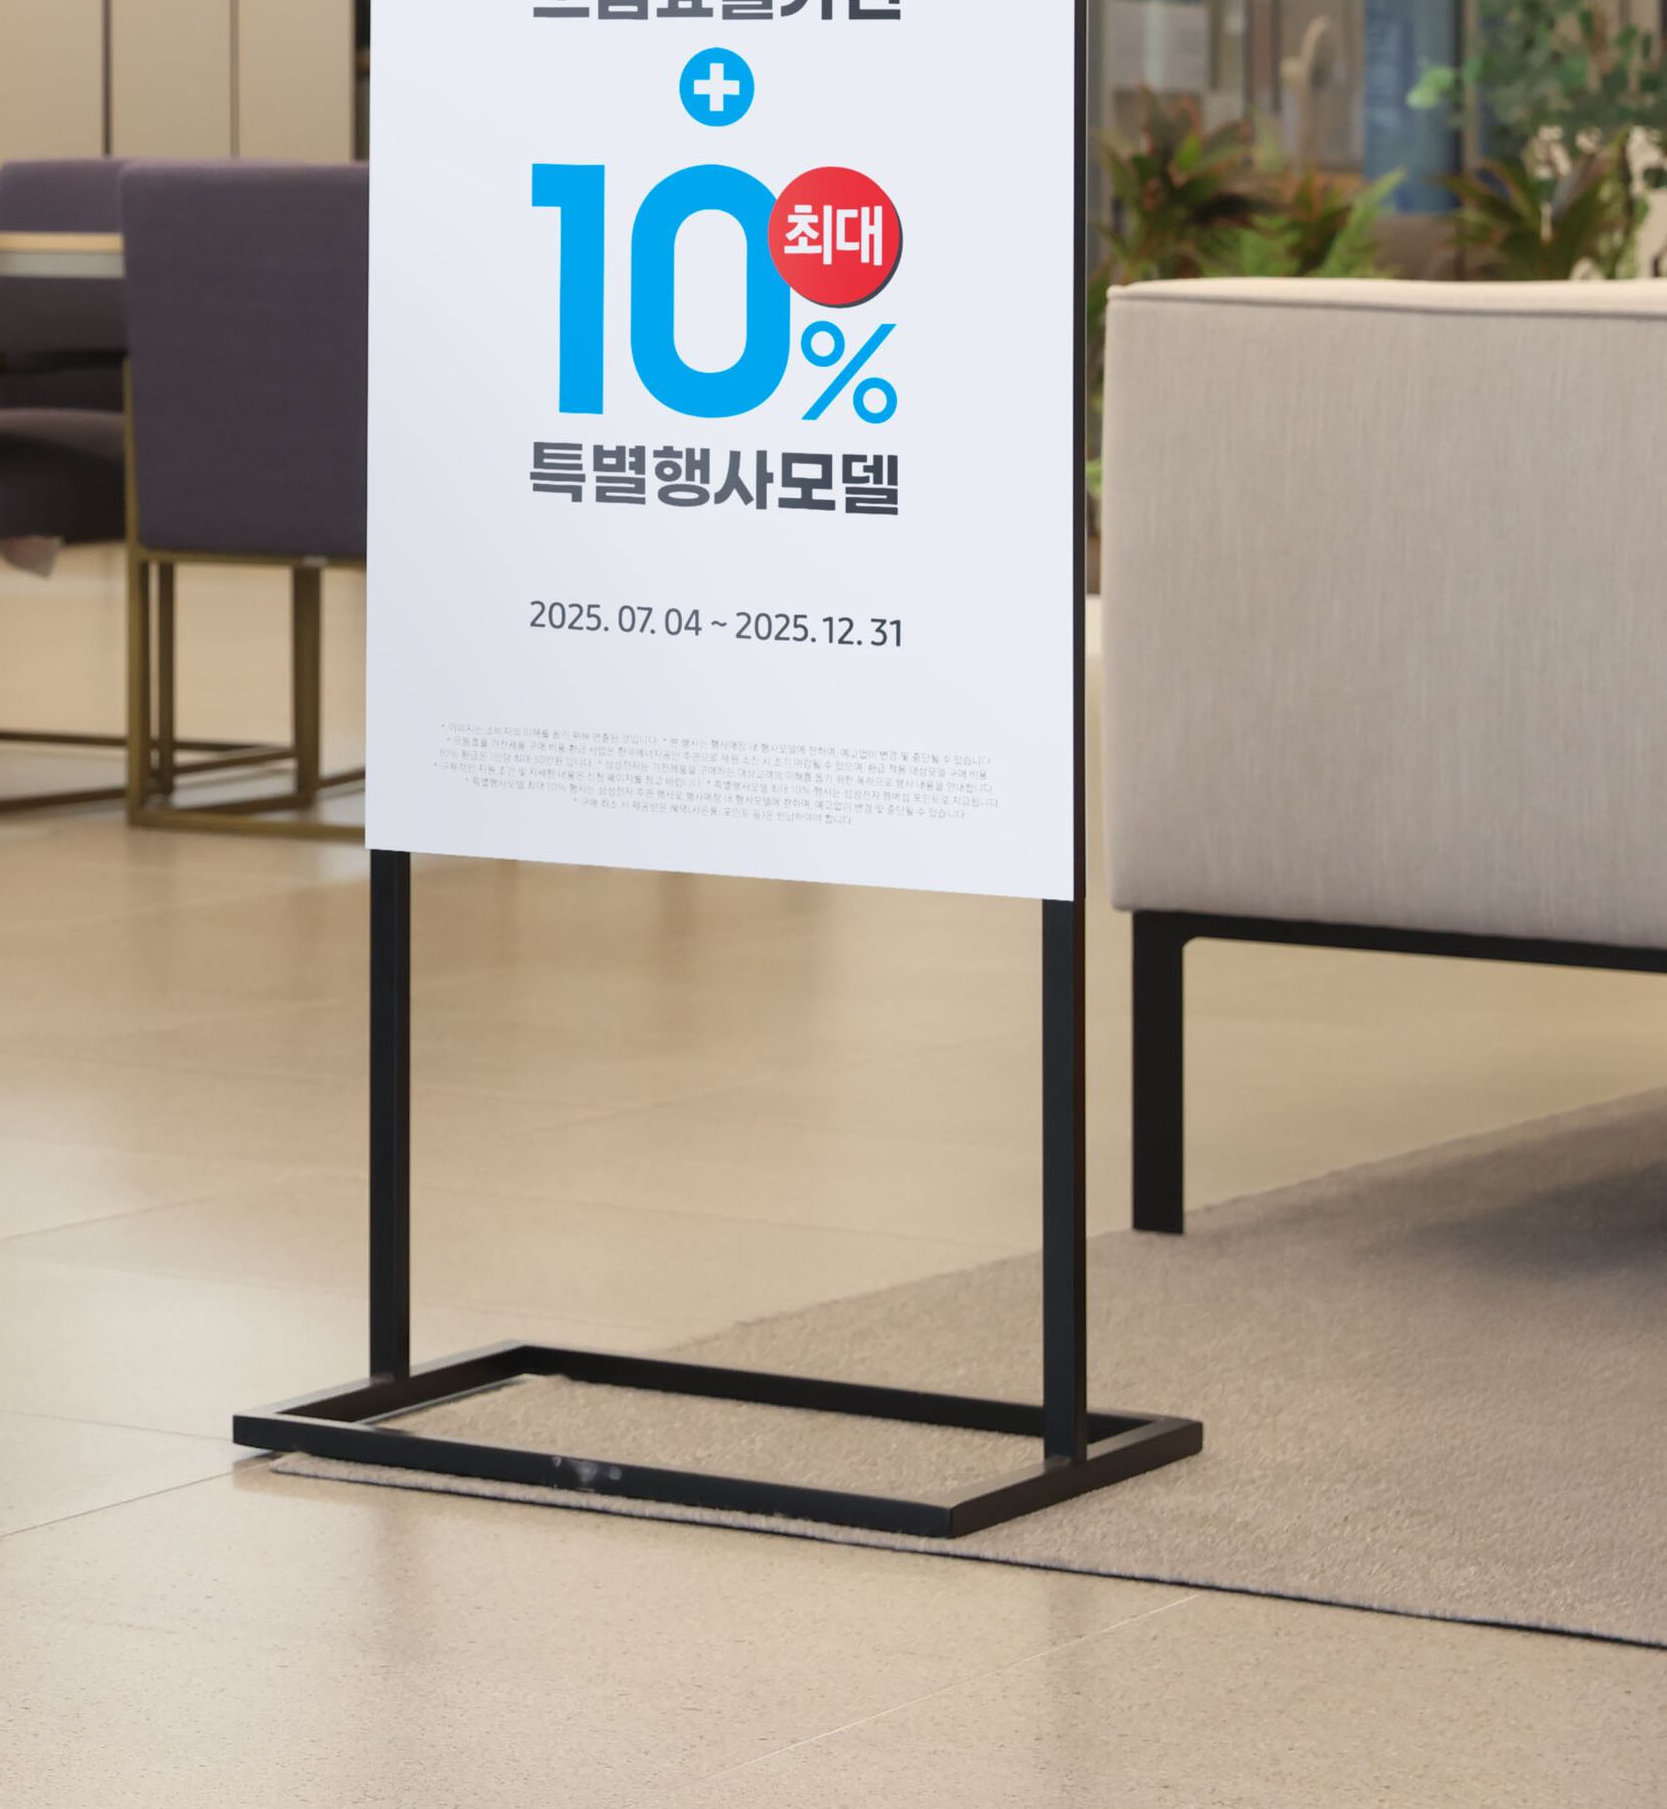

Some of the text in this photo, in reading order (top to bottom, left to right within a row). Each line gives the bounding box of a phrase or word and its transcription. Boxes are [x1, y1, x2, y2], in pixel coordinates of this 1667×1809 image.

[784, 204, 883, 267] 최대
[530, 162, 898, 424] 10%
[529, 441, 899, 516] 특별행사모델
[529, 600, 609, 632] 2025.
[618, 604, 656, 635] 07.
[664, 607, 703, 637] 04
[735, 611, 817, 643] 2025.
[822, 616, 863, 646] 12.
[870, 617, 903, 647] 31
